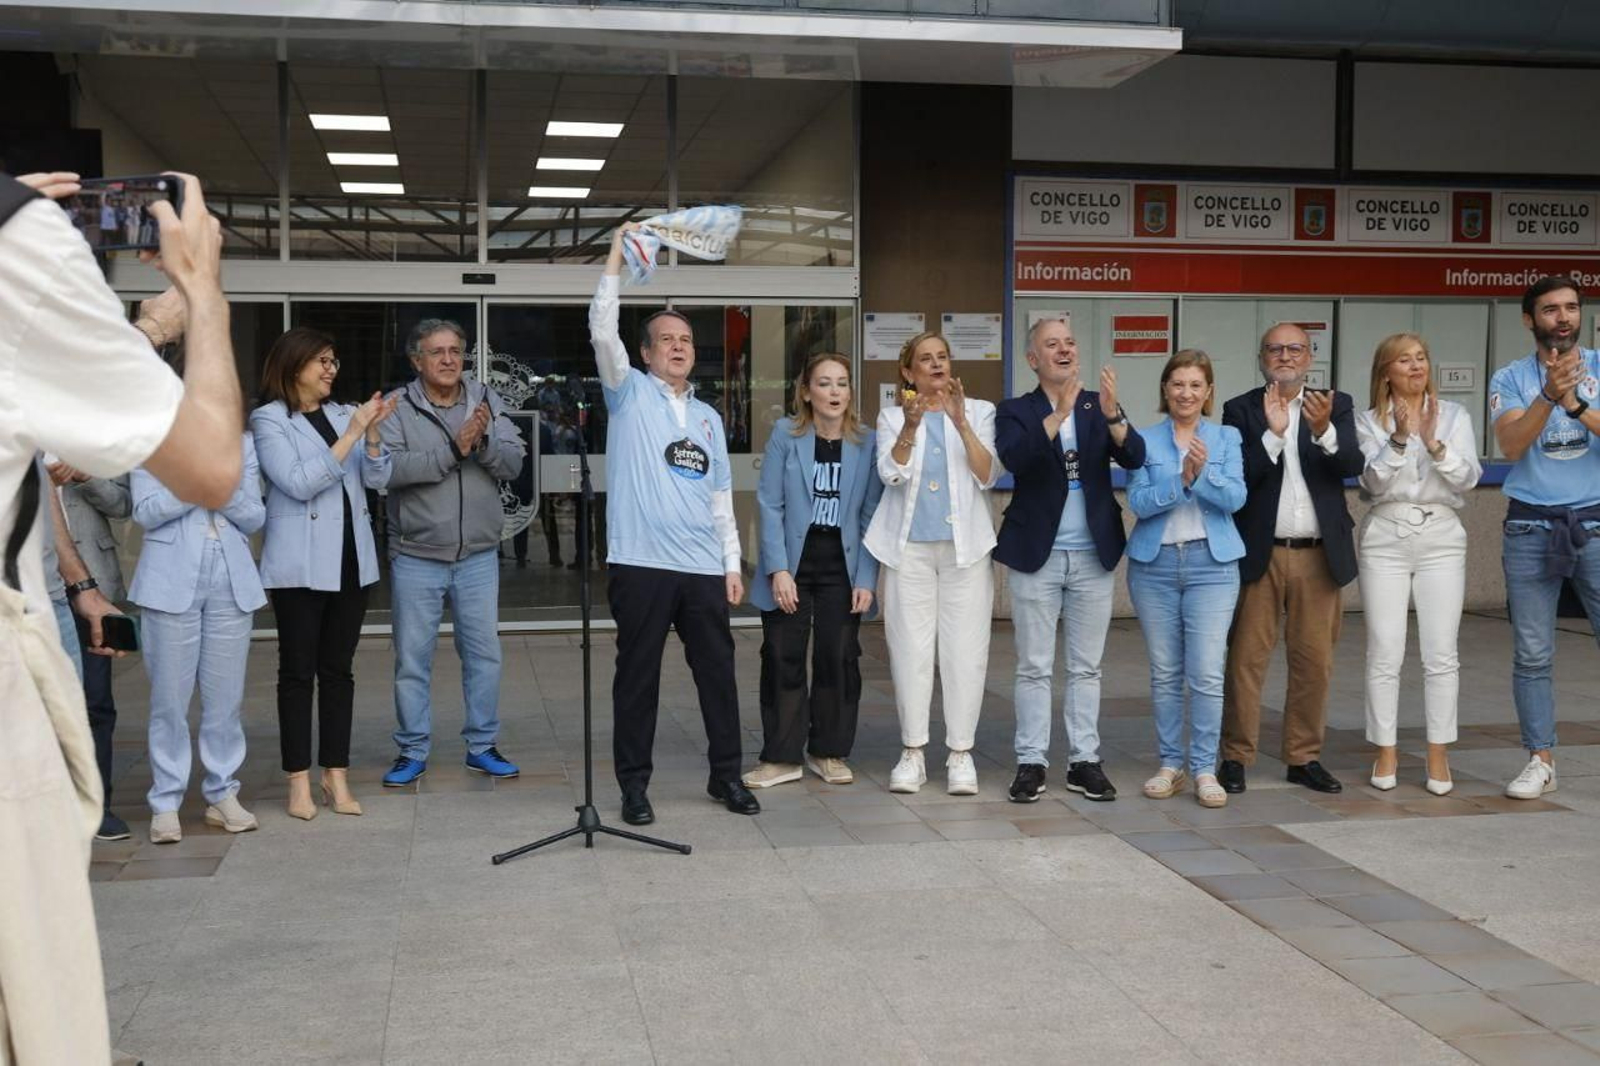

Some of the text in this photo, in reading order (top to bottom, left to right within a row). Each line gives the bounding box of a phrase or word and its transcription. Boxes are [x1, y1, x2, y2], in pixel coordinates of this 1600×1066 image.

[1030, 192, 1121, 207] CONCELLO
[1194, 196, 1281, 211] CONCELLO
[1356, 200, 1440, 214] CONCELLO
[1041, 210, 1110, 225] DE VIGO
[1507, 203, 1589, 218] CONCELLO
[1205, 214, 1271, 229] DE VIGO
[1366, 218, 1430, 232] DE VIGO
[1517, 220, 1579, 234] DE VIGO
[1017, 262, 1132, 281] Información
